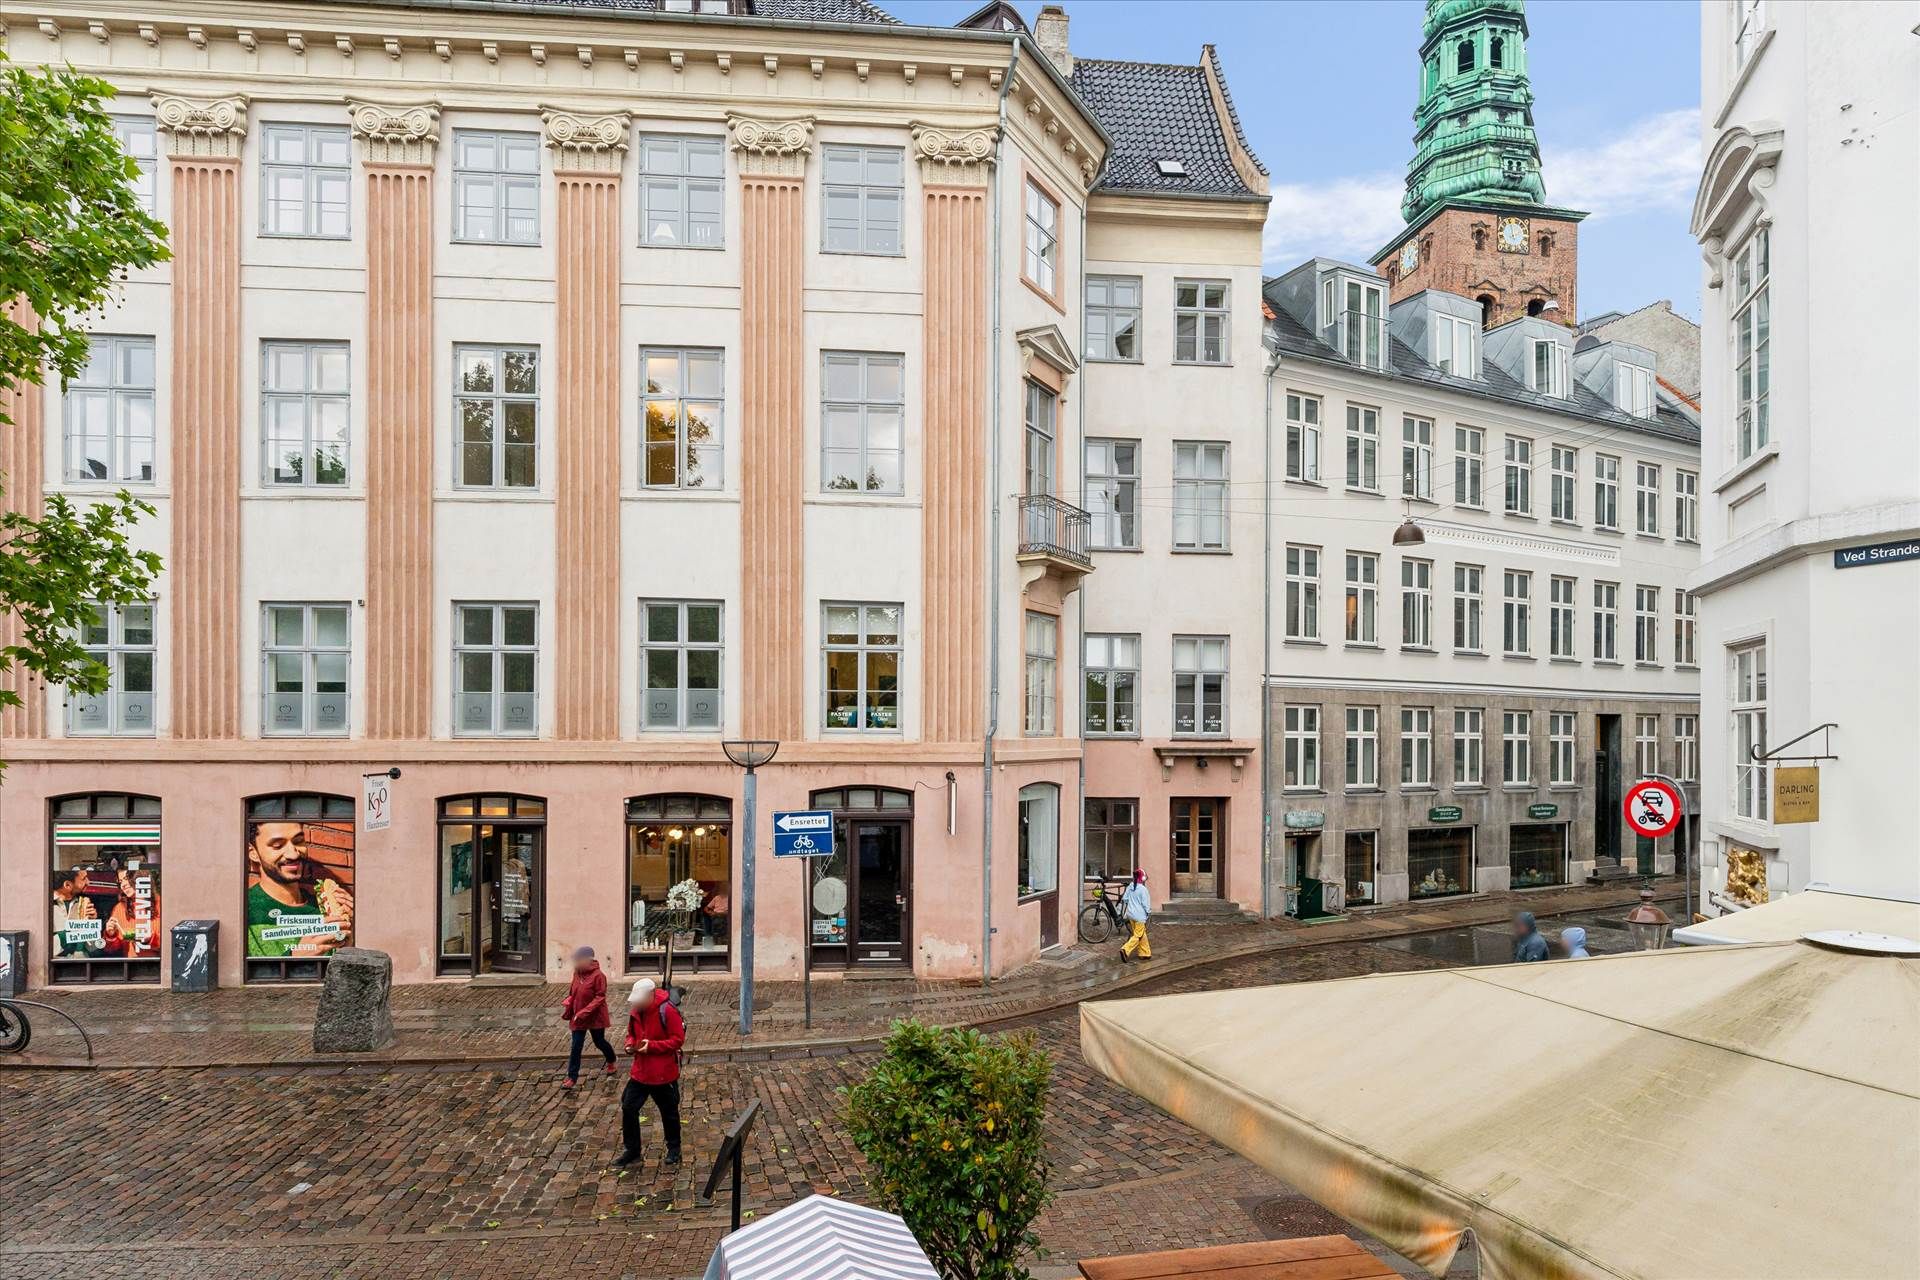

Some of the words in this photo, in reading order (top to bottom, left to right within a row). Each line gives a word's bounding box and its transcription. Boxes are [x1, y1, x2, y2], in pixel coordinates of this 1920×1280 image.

[1843, 550, 1866, 562] Ved
[1870, 544, 1920, 559] Strande
[1779, 784, 1815, 795] DARLING
[790, 818, 826, 826] Ensrettet
[69, 921, 90, 929] Værd
[91, 921, 99, 929] at
[80, 931, 98, 940] med
[264, 927, 302, 938] sandwich
[302, 926, 313, 936] på
[313, 924, 337, 933] farten
